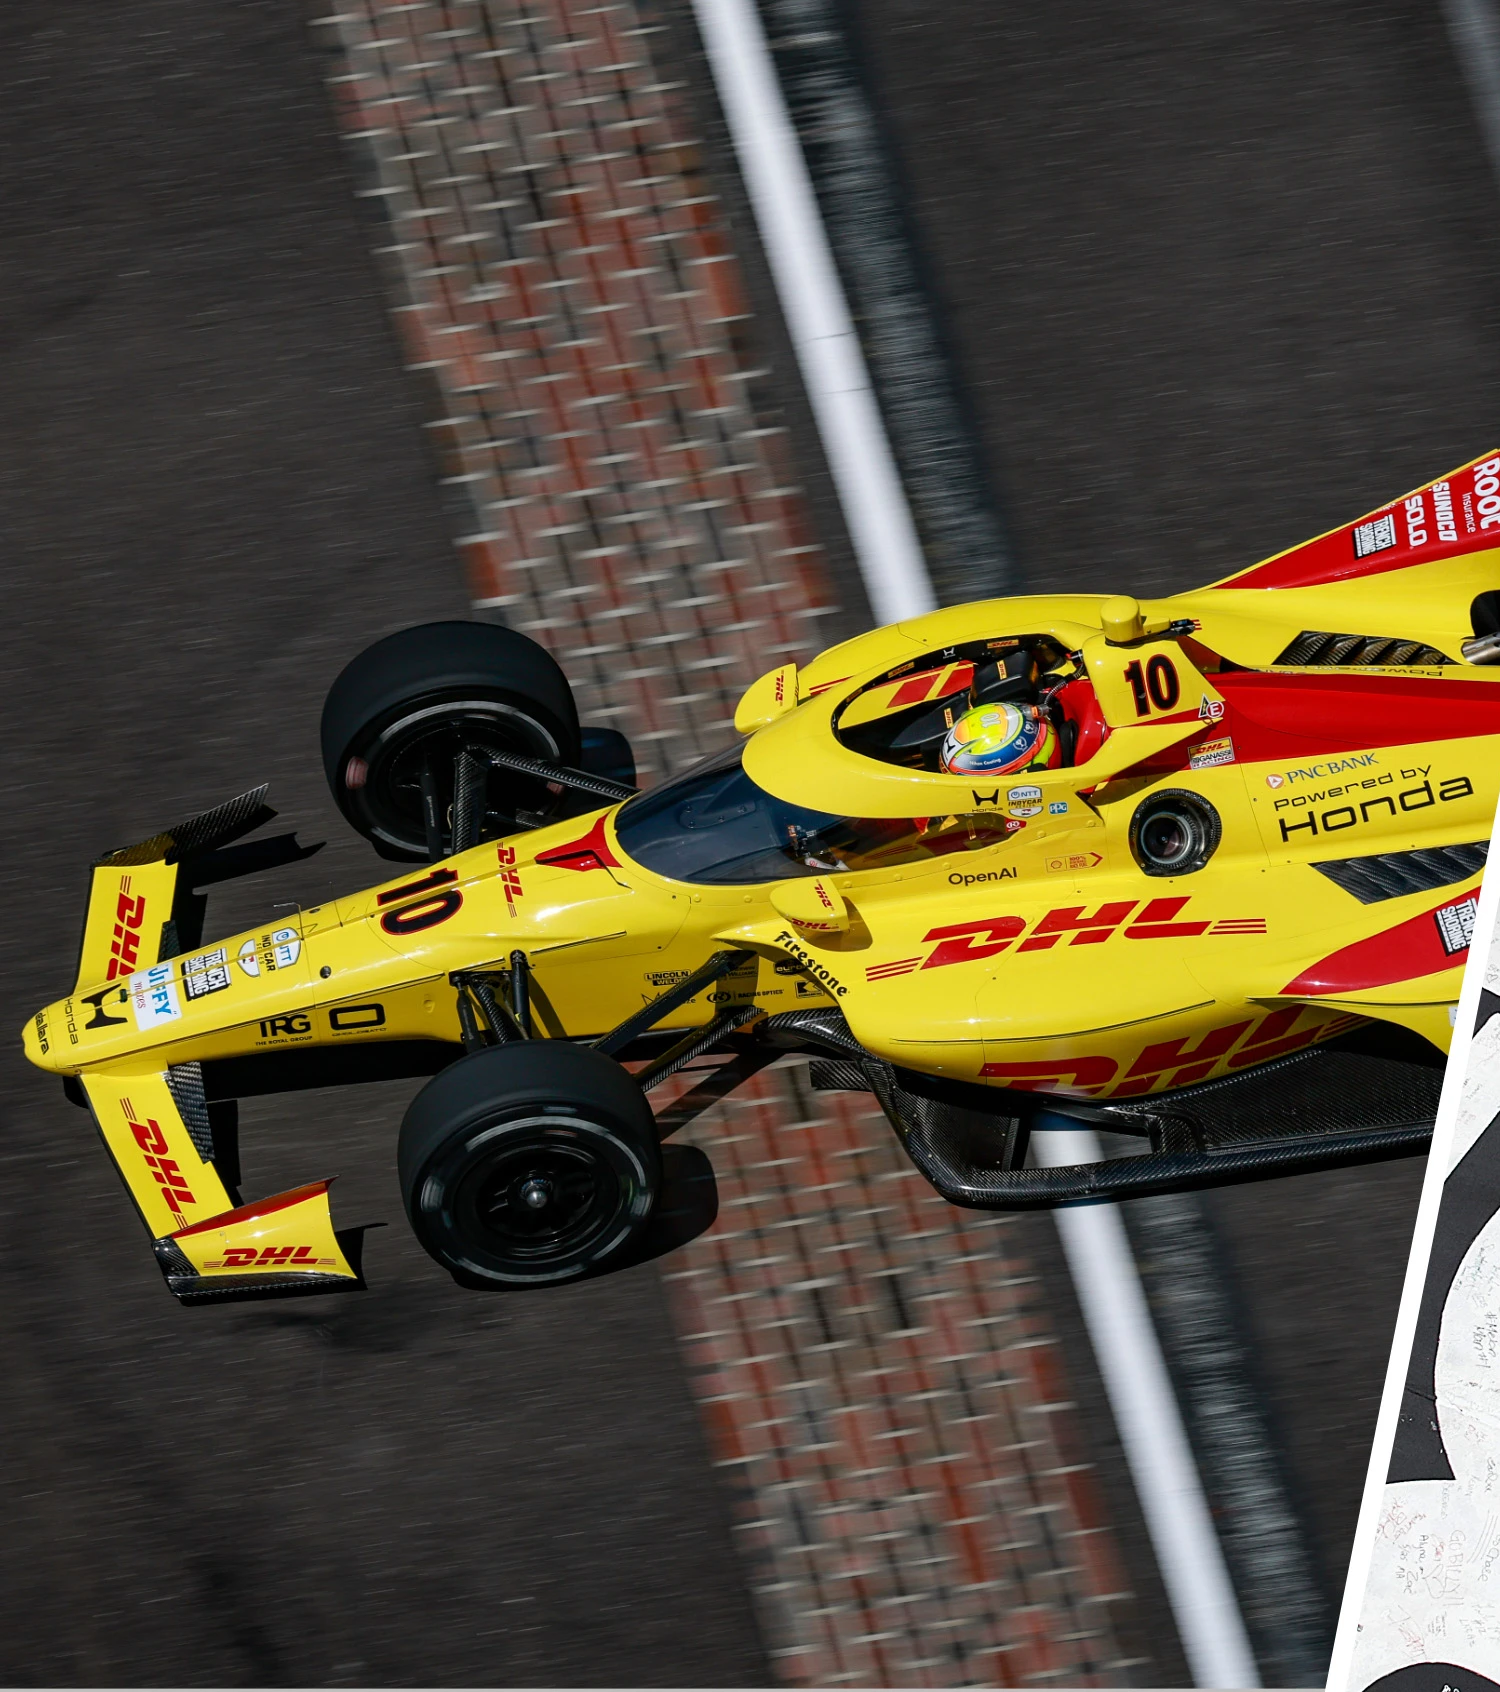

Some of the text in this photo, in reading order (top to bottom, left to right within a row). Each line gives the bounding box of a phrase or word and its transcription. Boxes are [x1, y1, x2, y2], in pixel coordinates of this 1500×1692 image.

[1405, 494, 1427, 547] SOLO
[1433, 481, 1457, 541] SUNOCO
[1462, 492, 1476, 533] Insurance
[1360, 522, 1375, 555] SHORING
[1374, 514, 1392, 550] TRENCH
[775, 676, 785, 703] DHL
[1123, 653, 1181, 718] 10
[1195, 742, 1225, 755] DHL
[1200, 749, 1232, 762] GANASSI
[1285, 752, 1380, 784] PNC BANK
[1008, 798, 1043, 807] INDYCAR
[1020, 789, 1038, 798] NTT
[1049, 802, 1067, 814] PPG
[1273, 763, 1432, 812] Powered by
[1278, 776, 1475, 843] Honda
[498, 846, 523, 904] DHL
[948, 866, 1018, 887] OpenAI
[376, 867, 464, 936] 10
[107, 895, 146, 982] DHL
[791, 917, 831, 930] DHL
[919, 896, 1212, 970] DHL
[1441, 905, 1467, 950] SHORING
[261, 934, 276, 973] INDCAR
[773, 930, 848, 997] Firestone
[645, 970, 689, 980] LINCOLN
[34, 1012, 50, 1055] dallara
[64, 997, 79, 1045] Honda
[290, 1035, 313, 1043] GROUP
[977, 1003, 1326, 1100] DHL
[127, 1118, 196, 1215] DHL
[222, 1246, 320, 1267] DHL
